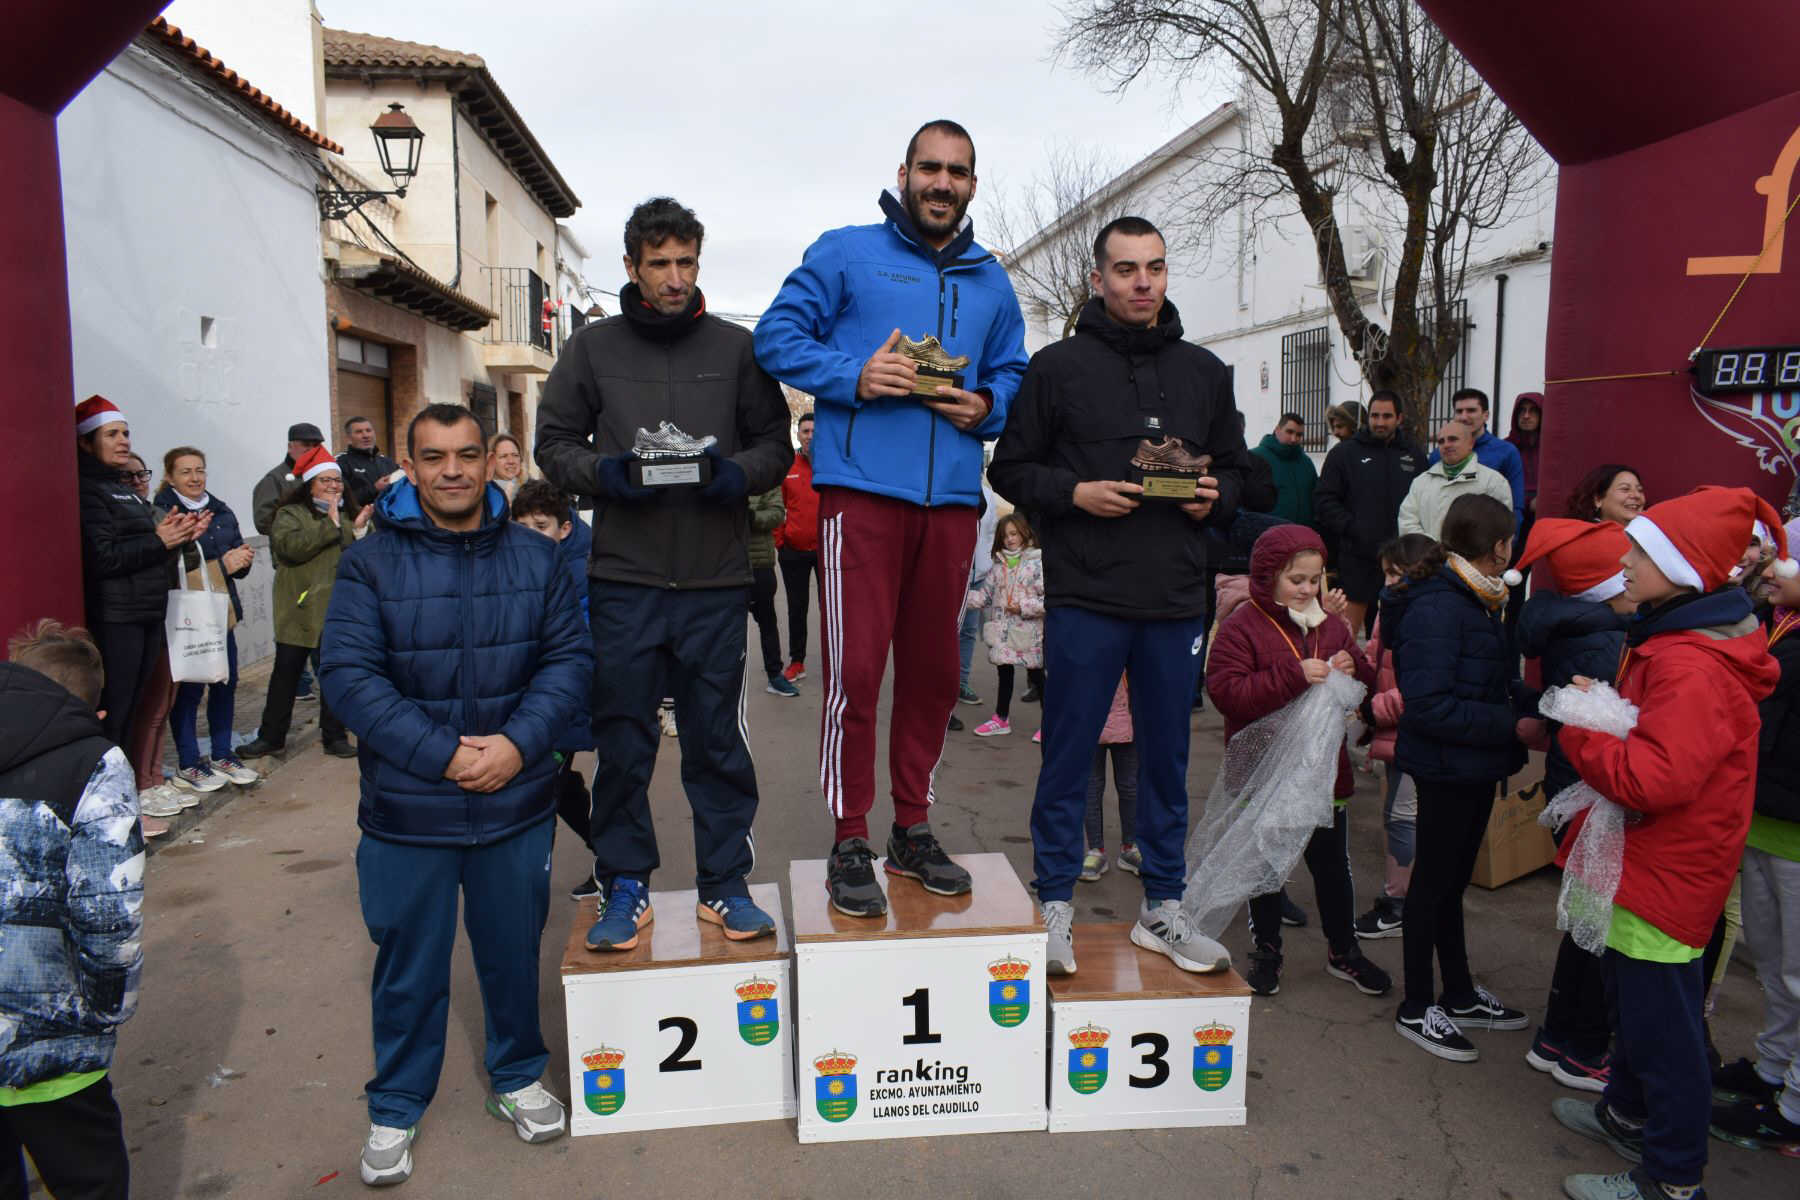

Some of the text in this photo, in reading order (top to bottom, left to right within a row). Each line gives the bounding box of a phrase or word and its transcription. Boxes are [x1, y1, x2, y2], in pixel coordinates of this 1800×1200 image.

[902, 988, 942, 1045] 1
[658, 1016, 702, 1072] 2
[1128, 1032, 1170, 1089] 3
[870, 1082, 982, 1101] EXCMO. AYUNTAMIENTO
[876, 1058, 969, 1084] ranking
[873, 1100, 979, 1118] LLANOS DEL CAUDILLO
